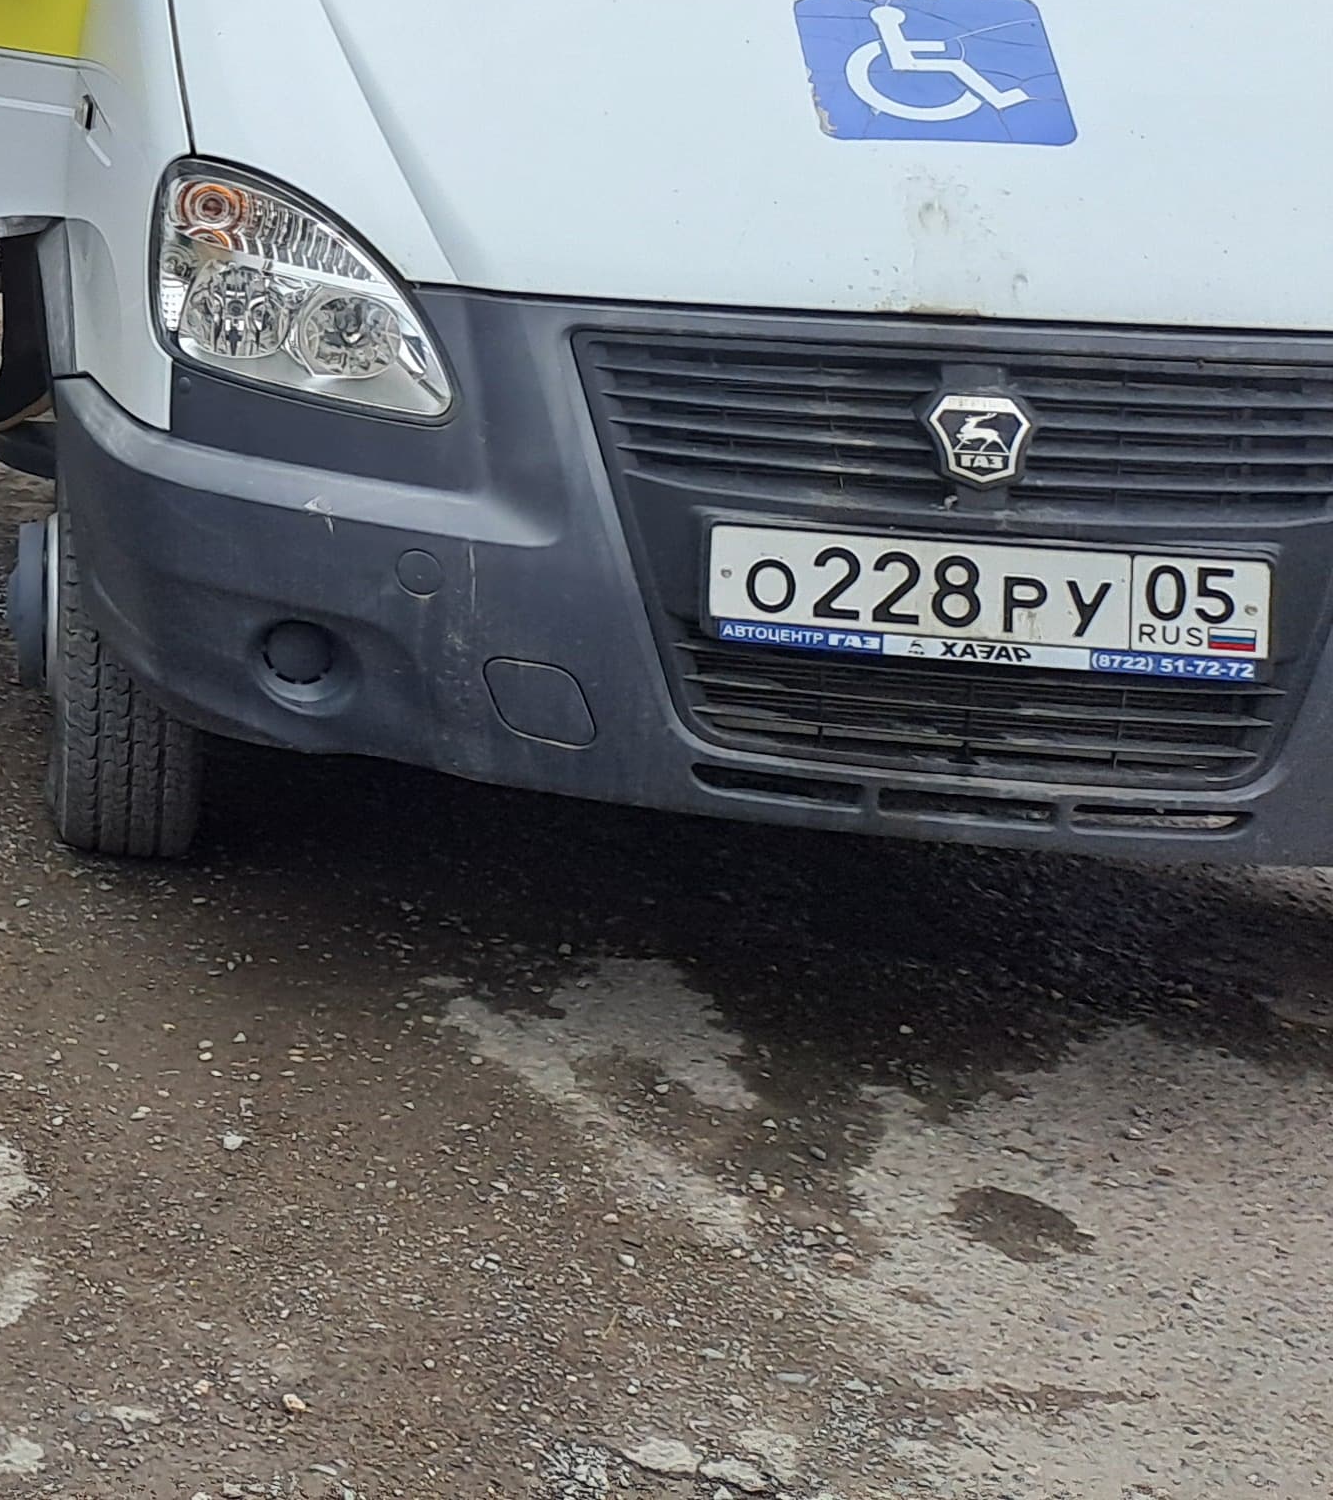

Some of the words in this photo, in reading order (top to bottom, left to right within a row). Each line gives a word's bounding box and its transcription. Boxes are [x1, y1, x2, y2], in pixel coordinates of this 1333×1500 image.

[960, 454, 1004, 470] ГАЗ
[1145, 564, 1235, 624] 05
[722, 624, 824, 645] АВТОЦЕНТР
[828, 633, 881, 650] ГАЗ
[1138, 623, 1203, 647] RUS
[1091, 651, 1154, 672] (8722)
[1160, 654, 1255, 679] 51-72-72
